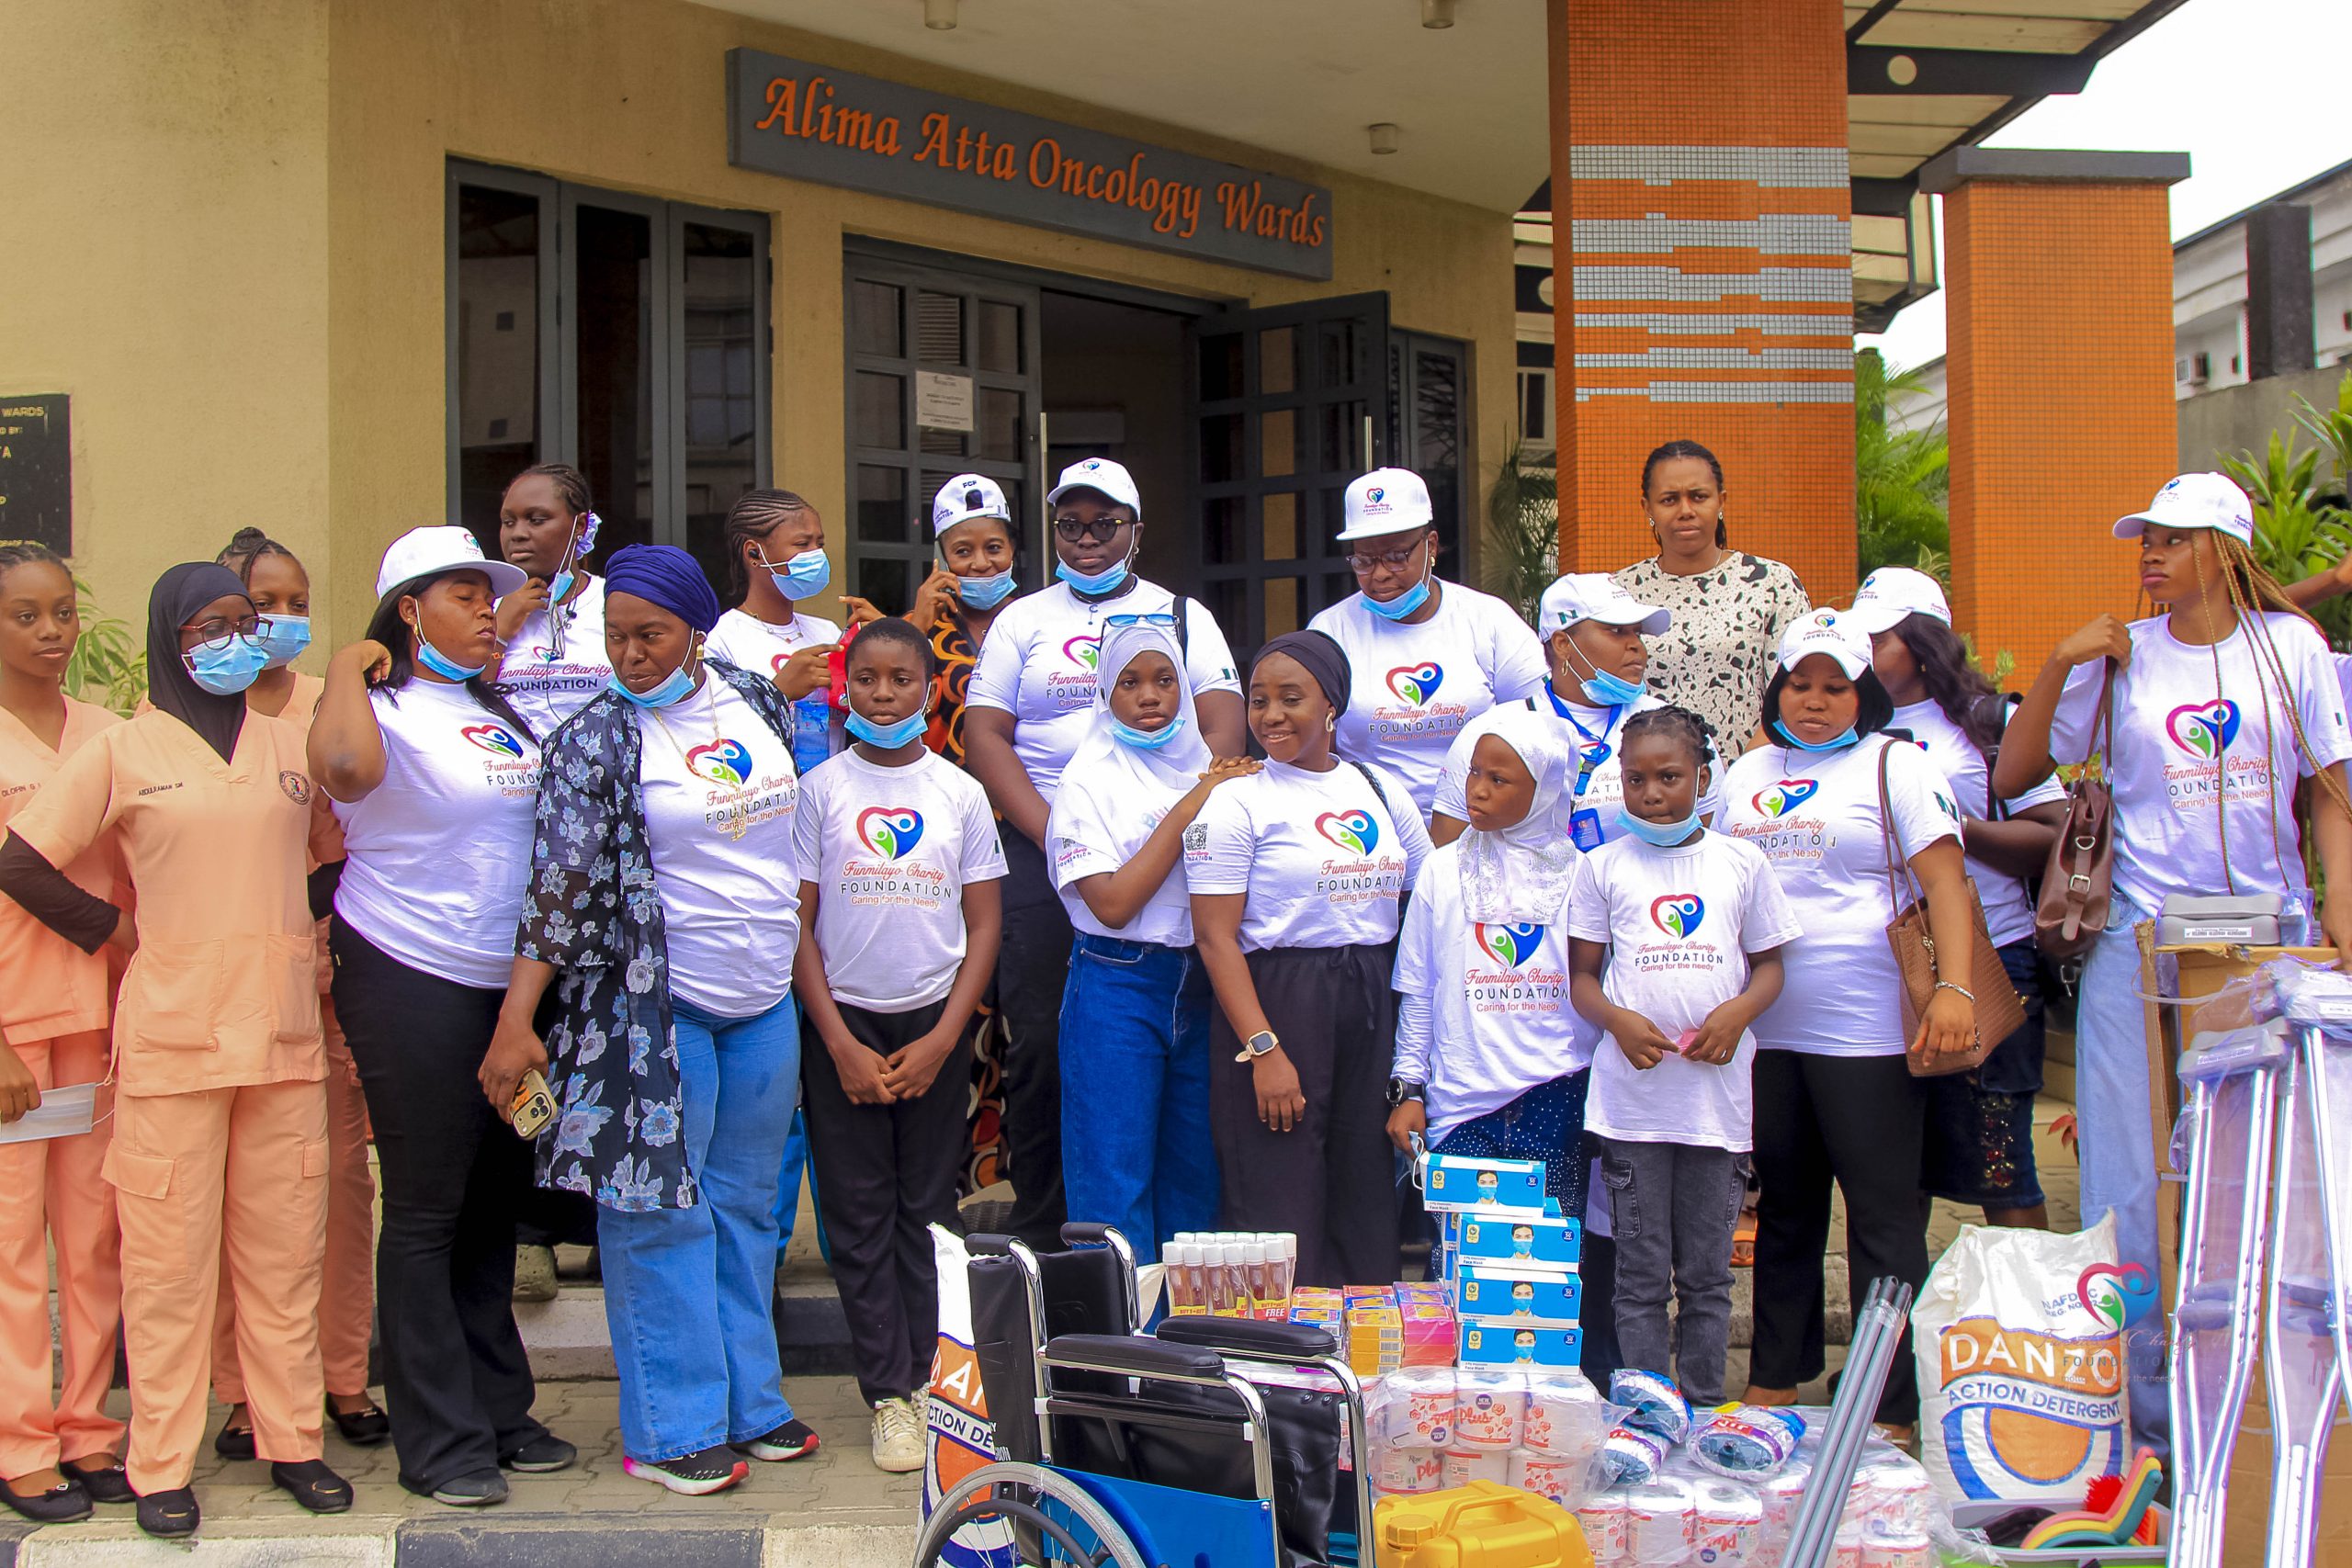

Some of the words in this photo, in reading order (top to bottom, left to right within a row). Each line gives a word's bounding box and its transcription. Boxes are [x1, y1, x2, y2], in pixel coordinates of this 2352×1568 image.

[756, 78, 900, 157] Alima
[913, 112, 1016, 181] Atta
[1028, 138, 1202, 237] Oncology
[1216, 181, 1325, 248] Wards
[2, 406, 45, 418] WARDS
[561, 663, 614, 678] Charity
[509, 678, 599, 693] OUNDATION
[1373, 705, 1426, 724] Funmilayo
[1430, 702, 1468, 720] Charity
[1369, 716, 1476, 734] FOUNDATIO
[482, 759, 532, 774] Funmilayo
[2226, 755, 2269, 774] Charity
[762, 773, 794, 790] Charity
[502, 787, 525, 797] Caring
[2172, 794, 2205, 809] Caring
[2222, 793, 2239, 802] the
[2242, 788, 2271, 801] Needy
[706, 787, 799, 825] FOUNDATIO
[1587, 796, 1600, 807] the
[747, 815, 758, 824] for
[760, 811, 773, 820] the
[1785, 815, 1826, 835] Charity
[842, 861, 902, 882] Funmilayo
[906, 861, 946, 885] Charity
[1321, 858, 1376, 877] Funmilayo
[1378, 855, 1405, 876] Charity
[841, 880, 952, 898] FOUNDATION
[1329, 890, 1357, 903] Caring
[1359, 890, 1369, 900] for
[851, 895, 879, 906] Caring
[881, 895, 894, 904] for
[896, 895, 910, 905] the
[912, 897, 940, 908] Needy
[1637, 941, 1683, 955] Funmilayo
[1685, 941, 1717, 953] Charity
[1634, 953, 1724, 967] FOUNDATION
[1641, 964, 1664, 973] Caring
[1665, 962, 1676, 970] for
[1691, 964, 1714, 972] needy
[1464, 967, 1524, 989] Funmilayo
[1527, 967, 1566, 988] Charity
[1464, 987, 1568, 1001] FOUNDATION
[1476, 1003, 1506, 1013] Caring
[1508, 1002, 1520, 1011] for
[1521, 1002, 1536, 1010] the
[1538, 1002, 1559, 1011] Needy
[2041, 1288, 2098, 1310] NAFDC
[1265, 1307, 1285, 1317] FREE
[1949, 1332, 2119, 1389] DANZO
[1948, 1382, 2027, 1405] ACTION
[2031, 1392, 2120, 1419] DETERGENT
[927, 1404, 968, 1436] CTION
